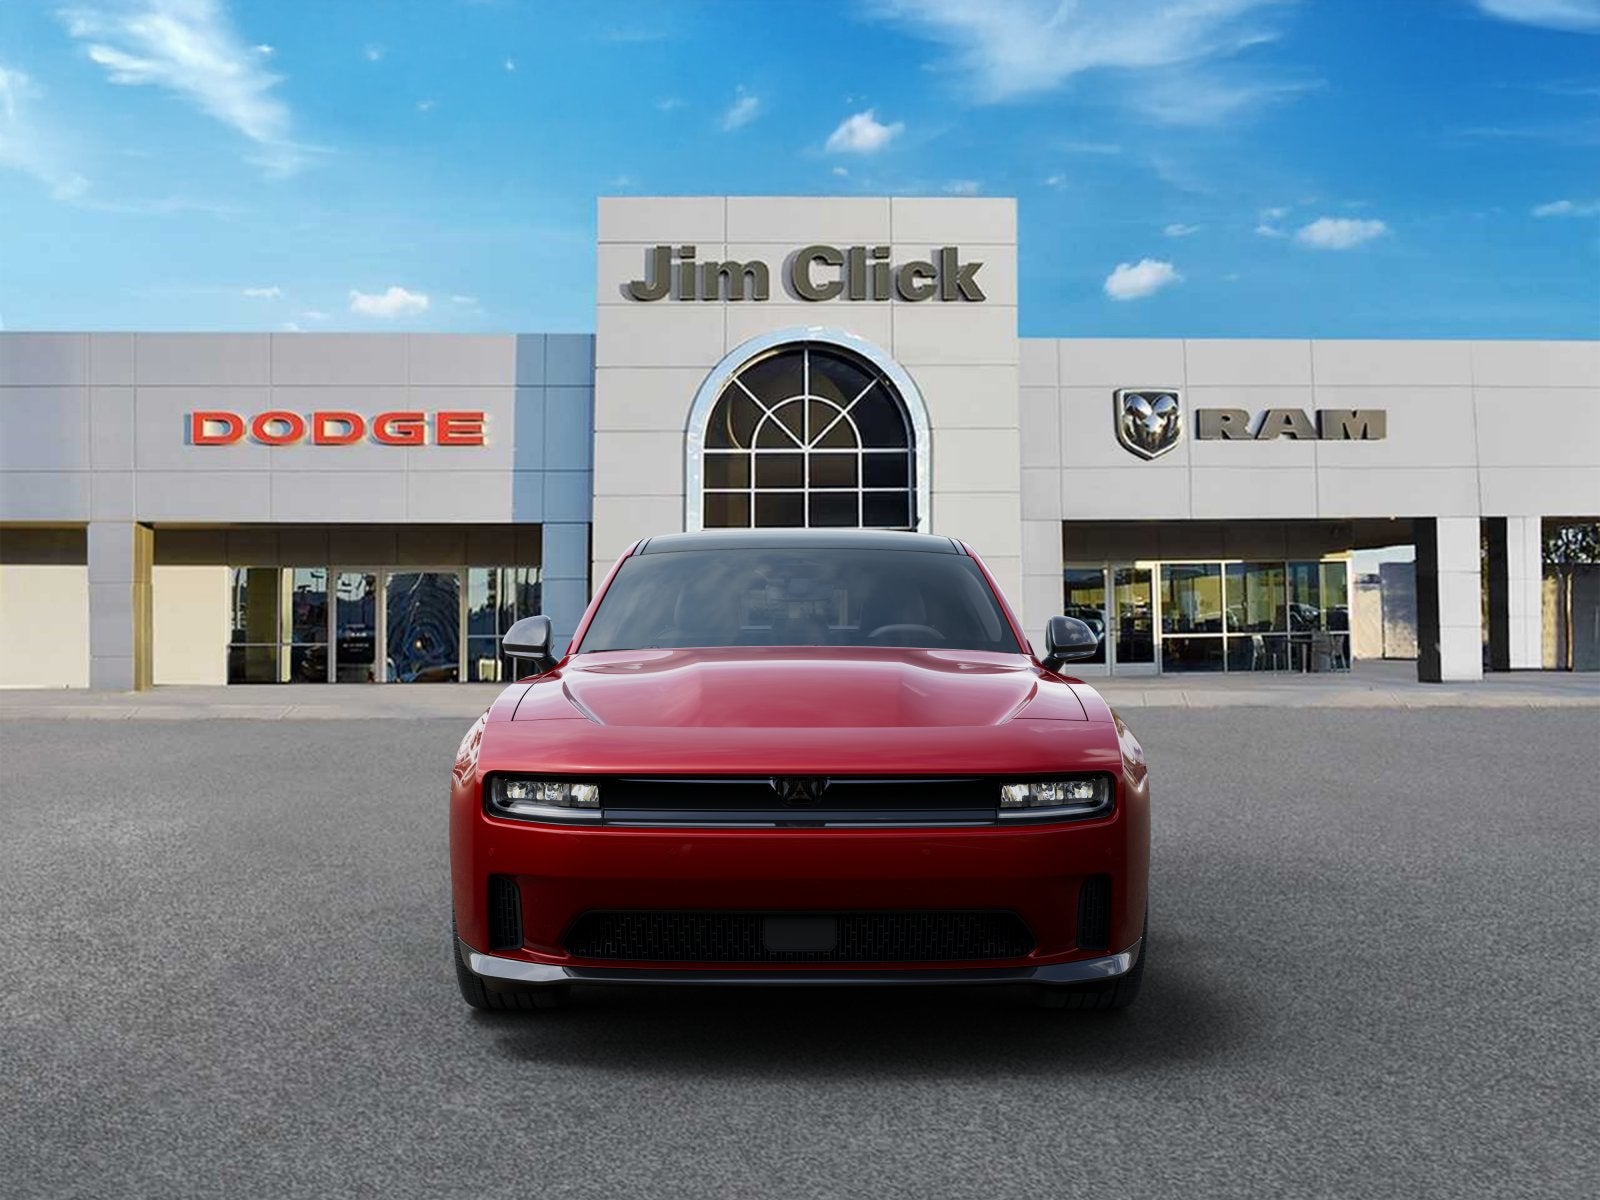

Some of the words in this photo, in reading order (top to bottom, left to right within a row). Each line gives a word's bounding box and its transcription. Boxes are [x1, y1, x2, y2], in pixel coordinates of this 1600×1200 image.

[628, 245, 769, 302] Jim
[789, 245, 986, 302] Click
[190, 410, 486, 446] DODGE
[1196, 408, 1387, 440] RAM
